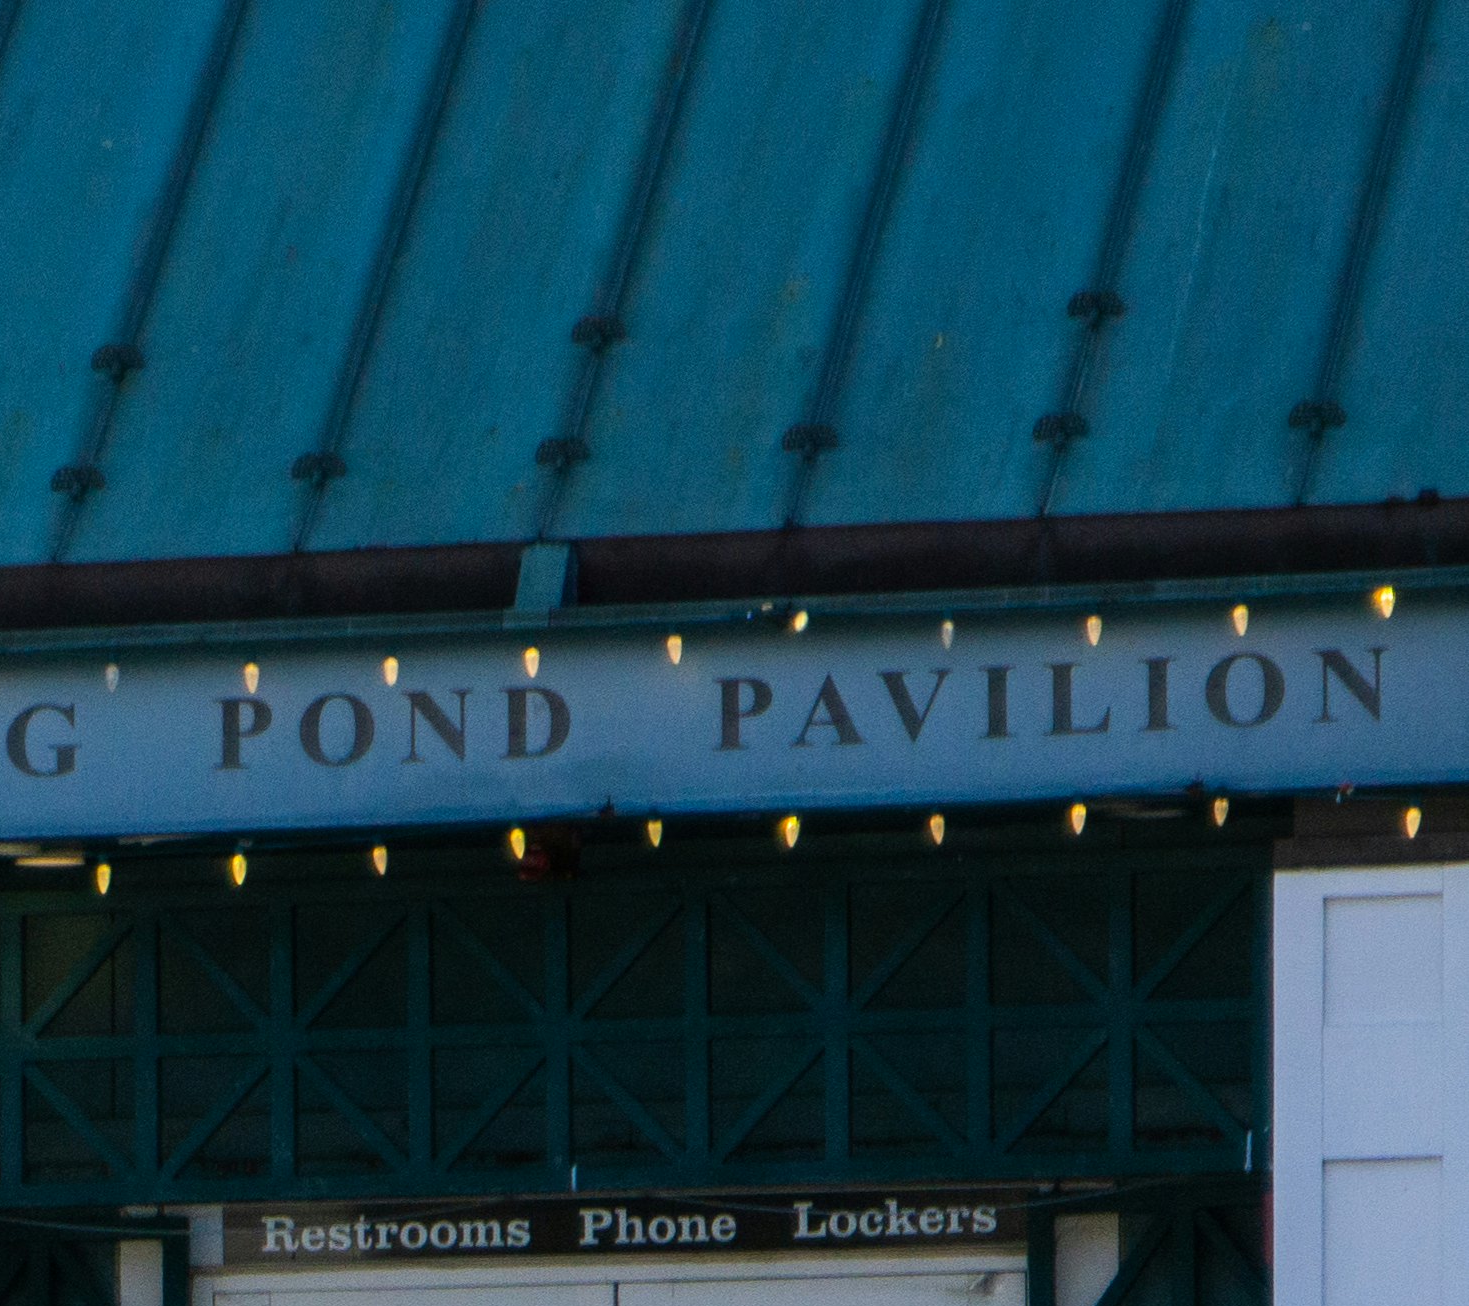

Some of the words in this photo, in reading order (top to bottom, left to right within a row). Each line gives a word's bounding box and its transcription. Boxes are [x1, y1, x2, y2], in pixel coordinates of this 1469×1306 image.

[214, 685, 572, 771] POND
[713, 646, 1386, 752] PAVILION
[261, 1213, 531, 1253] Restrooms
[578, 1207, 737, 1246] Phone
[793, 1200, 997, 1240] Lockers
